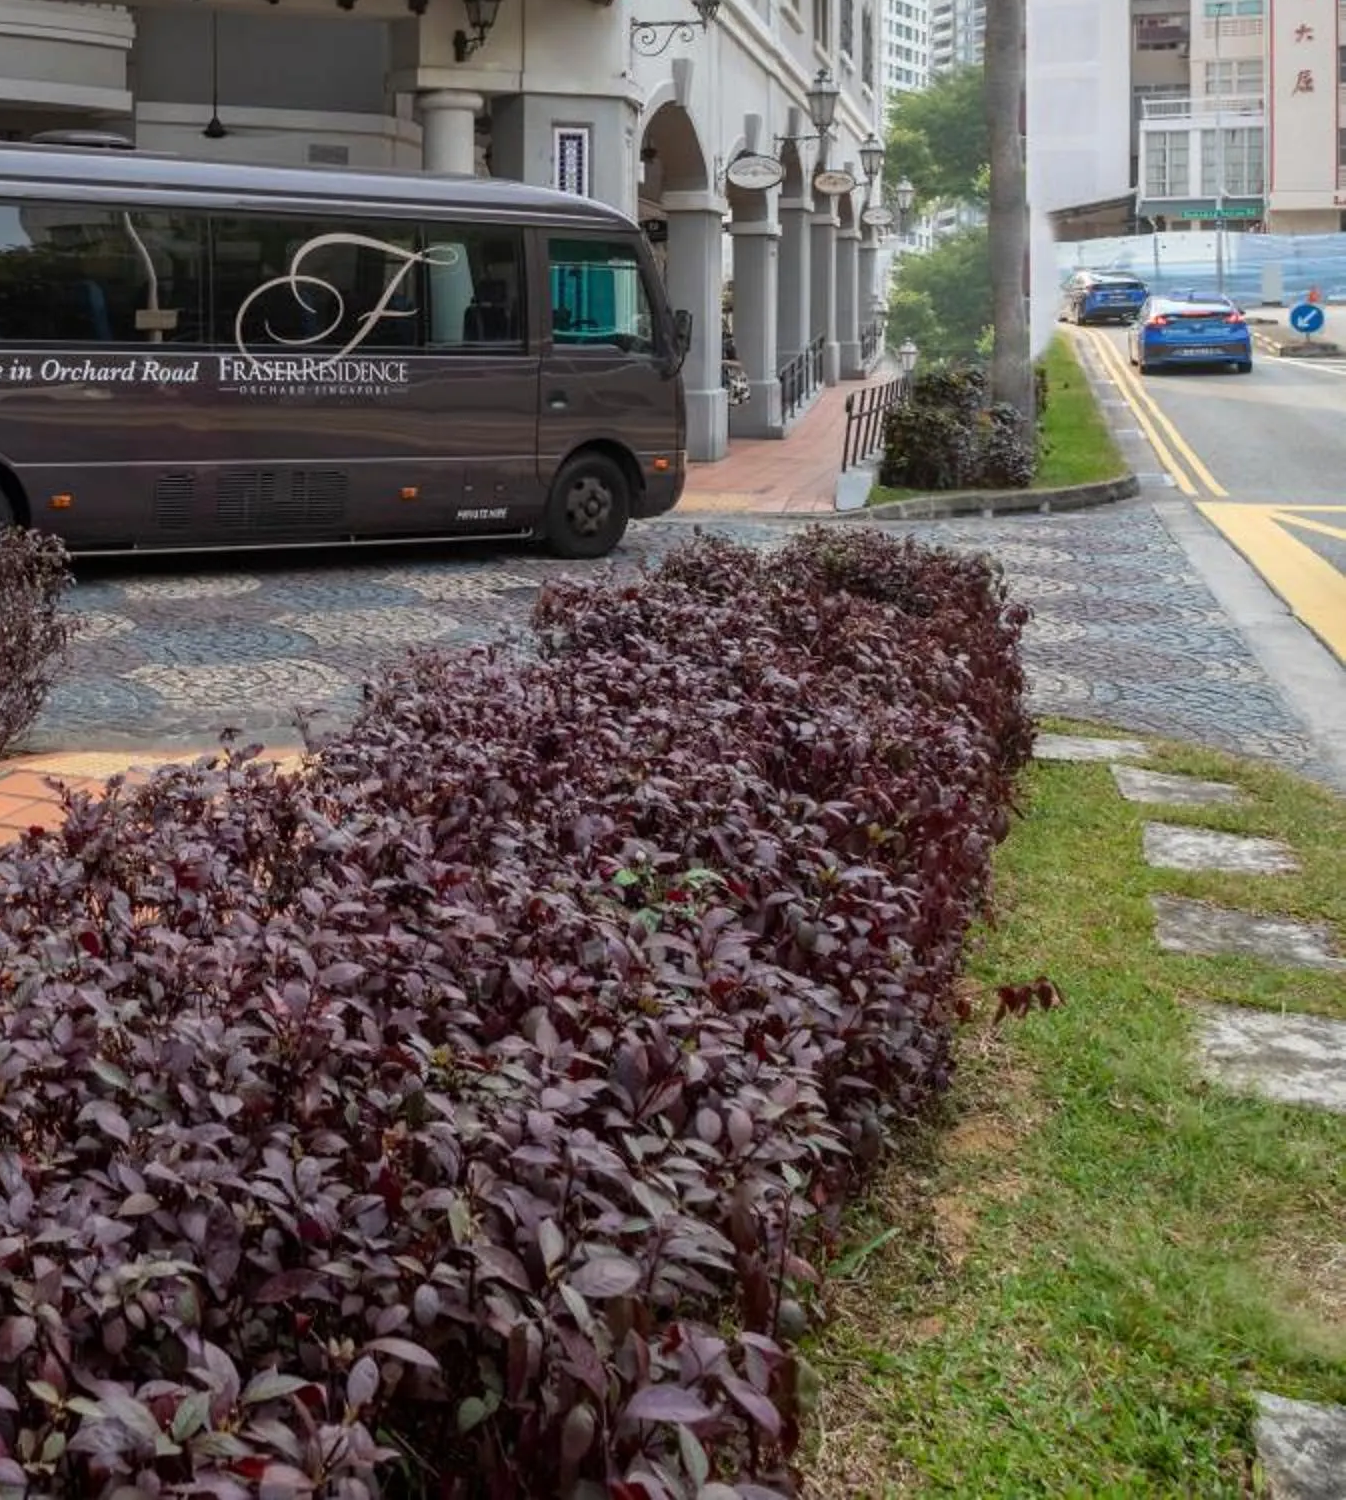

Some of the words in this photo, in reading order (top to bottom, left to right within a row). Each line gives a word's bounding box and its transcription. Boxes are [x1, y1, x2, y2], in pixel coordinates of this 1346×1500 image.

[10, 358, 33, 381] in
[40, 358, 136, 382] Orchard
[141, 360, 200, 384] Road
